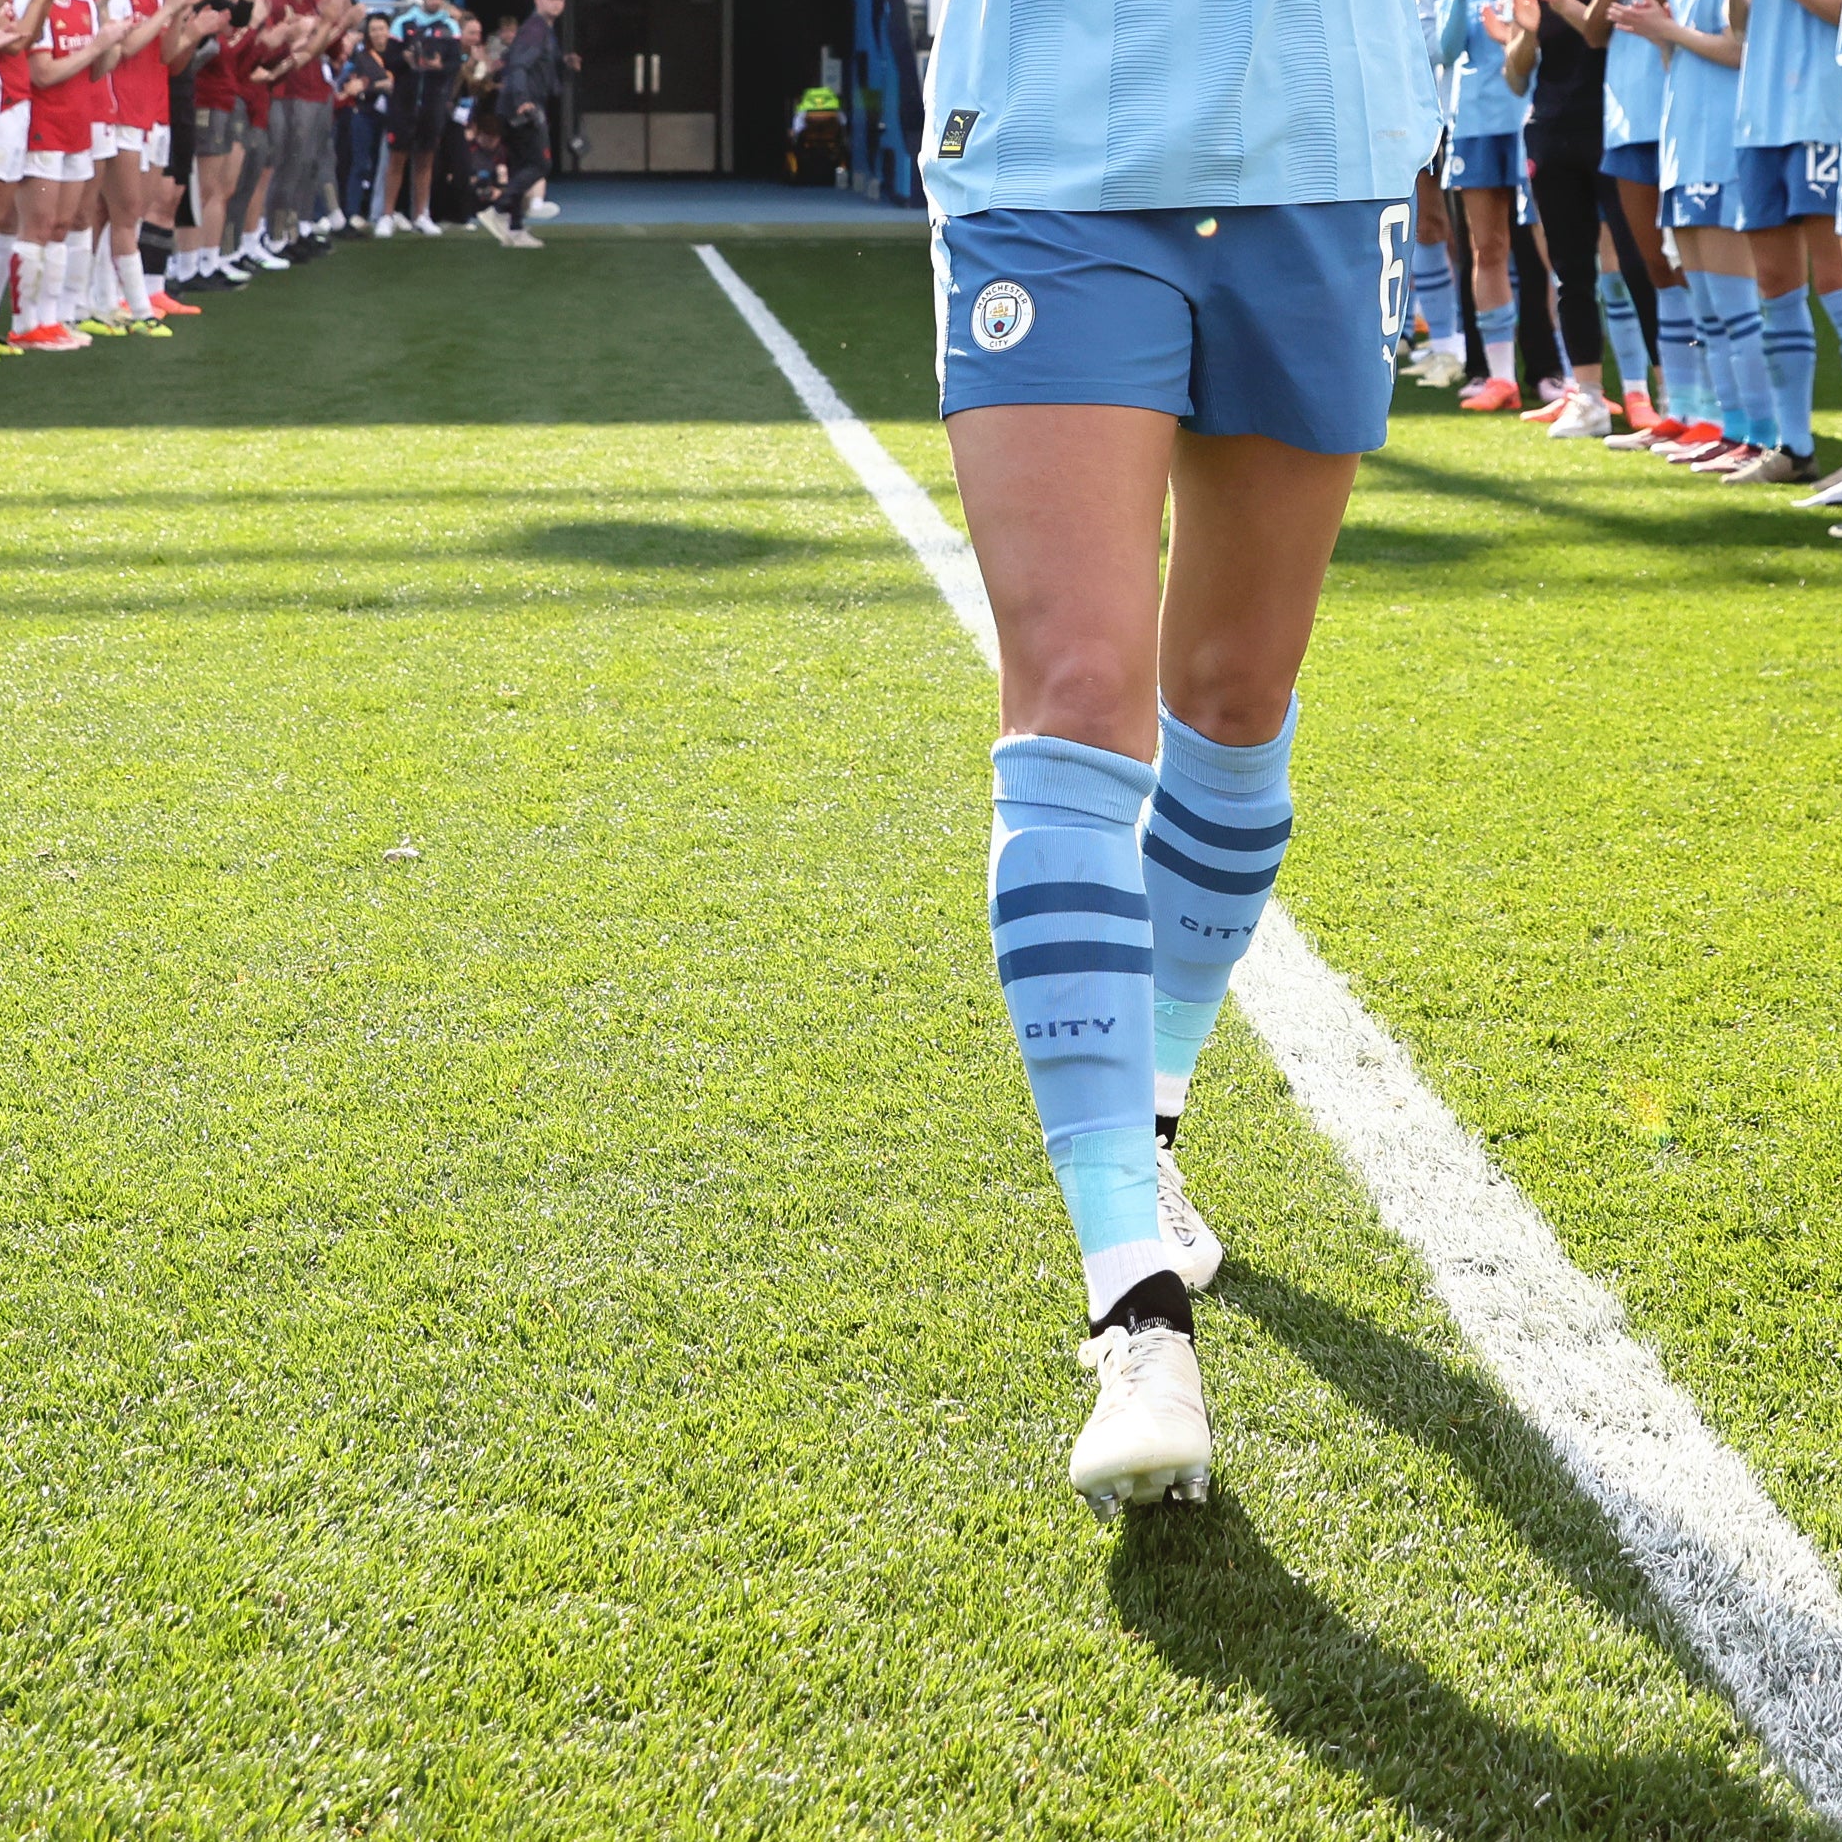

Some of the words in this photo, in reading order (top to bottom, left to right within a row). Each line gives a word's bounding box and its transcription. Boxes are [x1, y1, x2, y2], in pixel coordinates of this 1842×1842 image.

[1806, 141, 1840, 184] 12
[1379, 202, 1410, 337] 6
[977, 284, 1028, 310] MANCHESTER
[989, 339, 1009, 348] CITY
[1024, 1017, 1116, 1039] CITY
